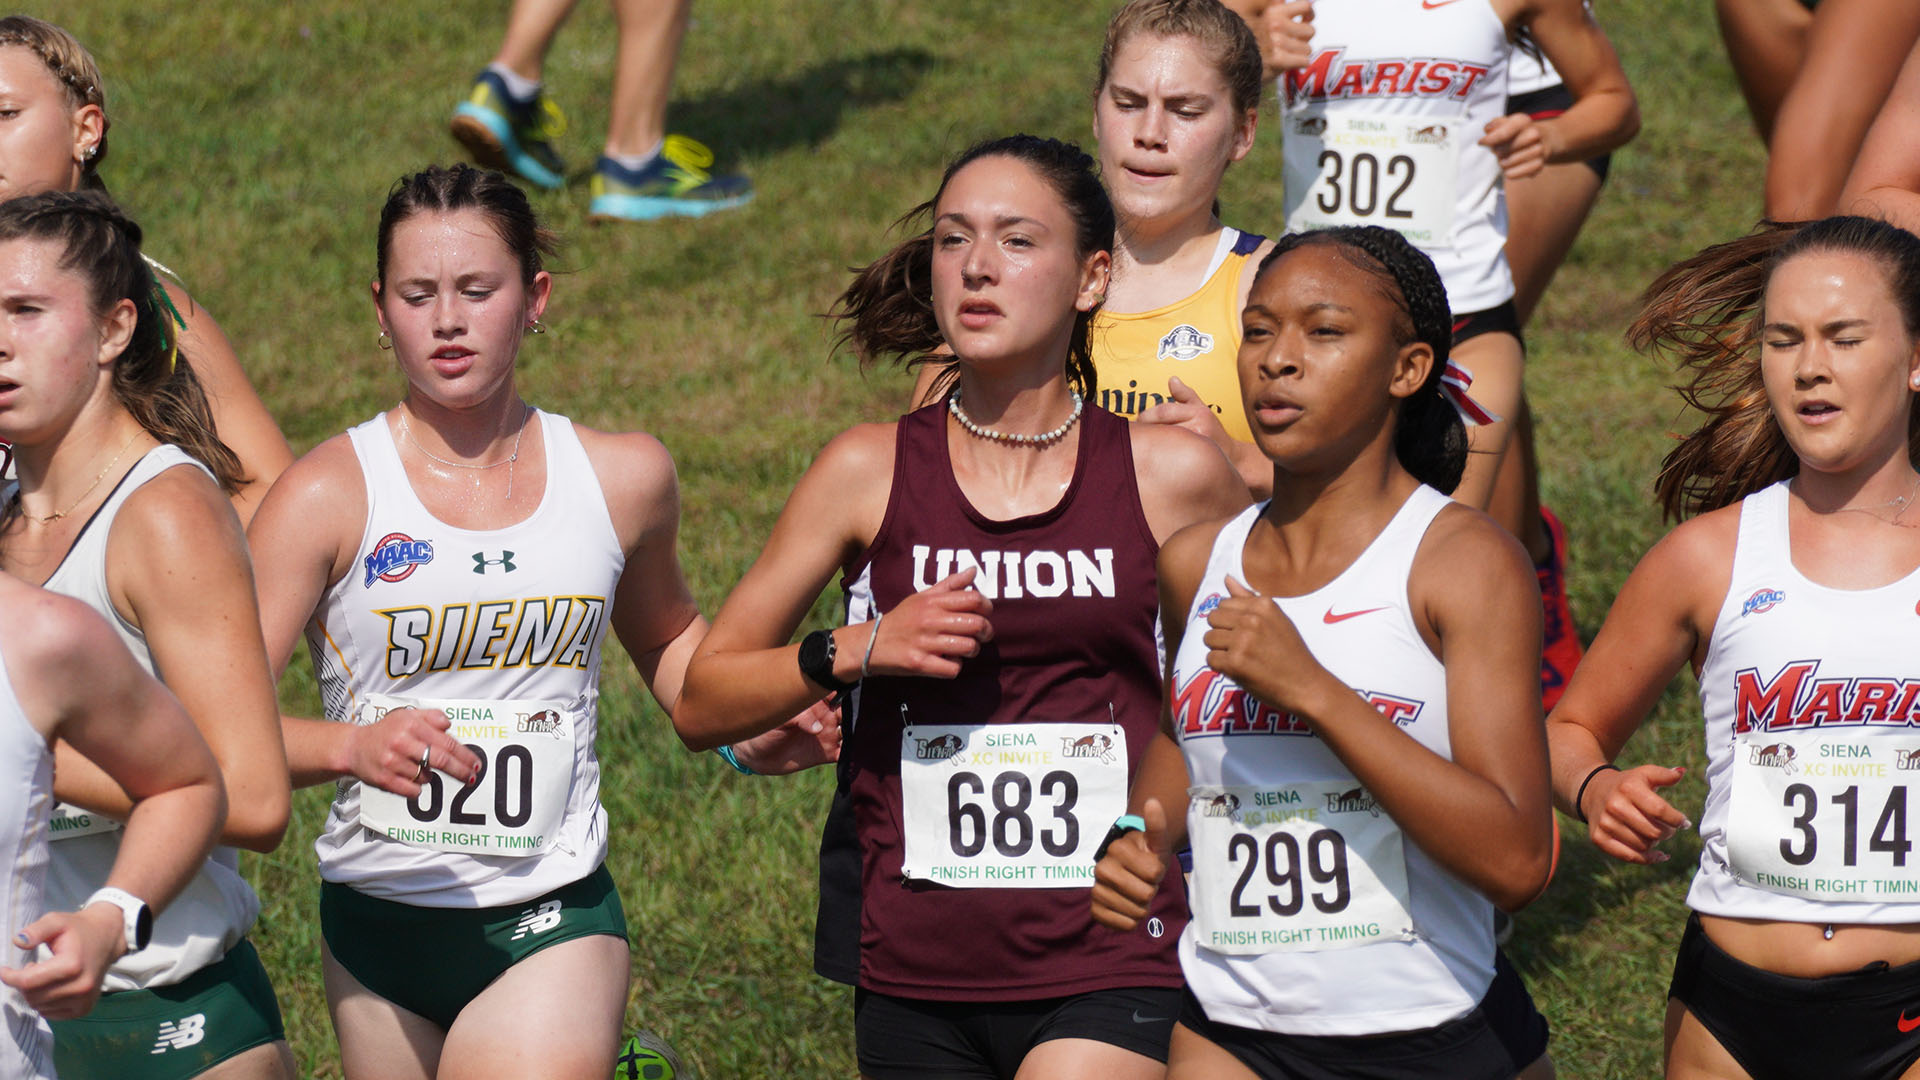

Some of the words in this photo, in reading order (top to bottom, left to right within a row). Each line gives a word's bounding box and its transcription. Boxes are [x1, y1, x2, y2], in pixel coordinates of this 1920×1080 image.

[1284, 47, 1492, 108] MARIST
[1347, 119, 1387, 131] SIENA
[1316, 149, 1416, 219] 302
[364, 540, 434, 589] MAAC
[912, 544, 1116, 600] UNION
[370, 594, 606, 681] SIENA
[1732, 659, 1920, 740] MARI
[445, 706, 495, 721] SIENA
[457, 725, 509, 740] INVITE
[985, 732, 1037, 747] SIENA
[970, 751, 994, 766] XC
[998, 750, 1053, 766] INVITE
[1820, 743, 1872, 758] SIENA
[1803, 763, 1828, 777] XC
[1831, 762, 1888, 778] INVITE
[1254, 789, 1302, 807] SIENA
[50, 814, 91, 832] MING
[947, 769, 1080, 858] 683
[1266, 807, 1320, 825] INVITE
[1779, 782, 1912, 868] 314
[387, 827, 437, 844] FINISH
[441, 831, 490, 848] RIGHT
[495, 834, 544, 850] TIMING
[930, 865, 980, 880] FINISH
[985, 864, 1037, 880] RIGHT
[1228, 828, 1351, 918] 299
[1756, 872, 1809, 891] FINISH
[1814, 878, 1868, 894] RIGHT
[1872, 878, 1920, 894] TIMIN
[1211, 930, 1257, 945] FINISH
[1261, 928, 1313, 945] RIGHT
[1317, 922, 1381, 942] TIMING
